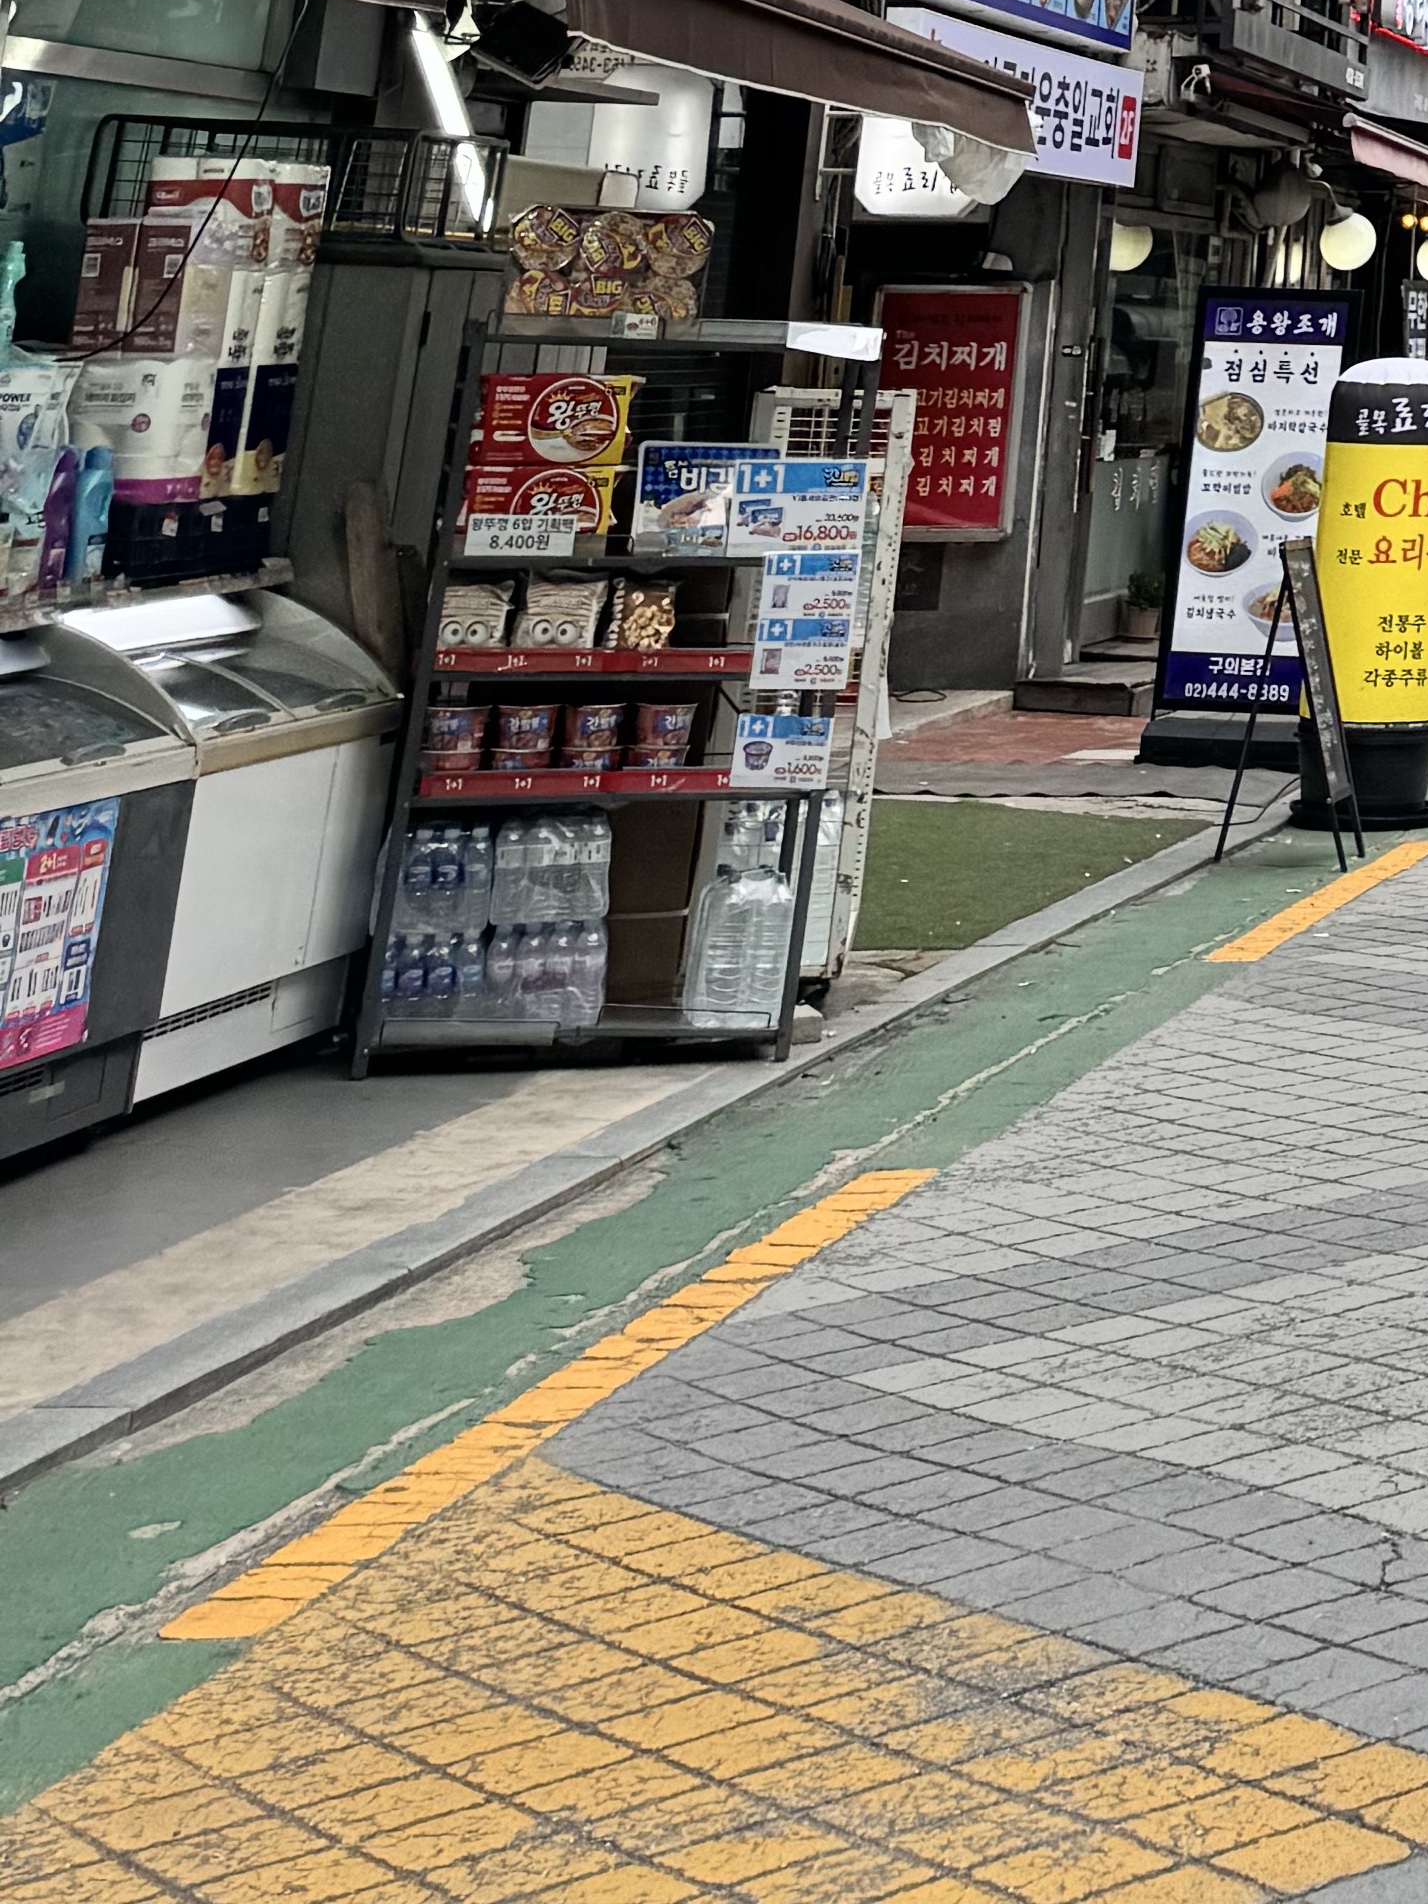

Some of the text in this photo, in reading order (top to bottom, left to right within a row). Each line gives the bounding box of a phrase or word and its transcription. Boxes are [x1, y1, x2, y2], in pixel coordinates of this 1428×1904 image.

[550, 218, 577, 243] BIG
[595, 279, 624, 295] BIG
[1246, 311, 1338, 337] 용왕조개
[893, 341, 1007, 371] 김치찌개
[1224, 358, 1319, 385] 점심특선
[919, 446, 999, 467] 김치찌개
[740, 464, 786, 493] 1+1
[915, 476, 997, 497] 김치찌개
[1340, 502, 1367, 519] 호텔
[769, 554, 801, 575] 1+1
[1336, 549, 1364, 566] 전문
[760, 619, 793, 641] 1+1
[1378, 615, 1426, 633] 전통주
[1376, 641, 1424, 660] 하이볼
[1364, 670, 1428, 688] 각종주류
[738, 715, 774, 738] 1+1
